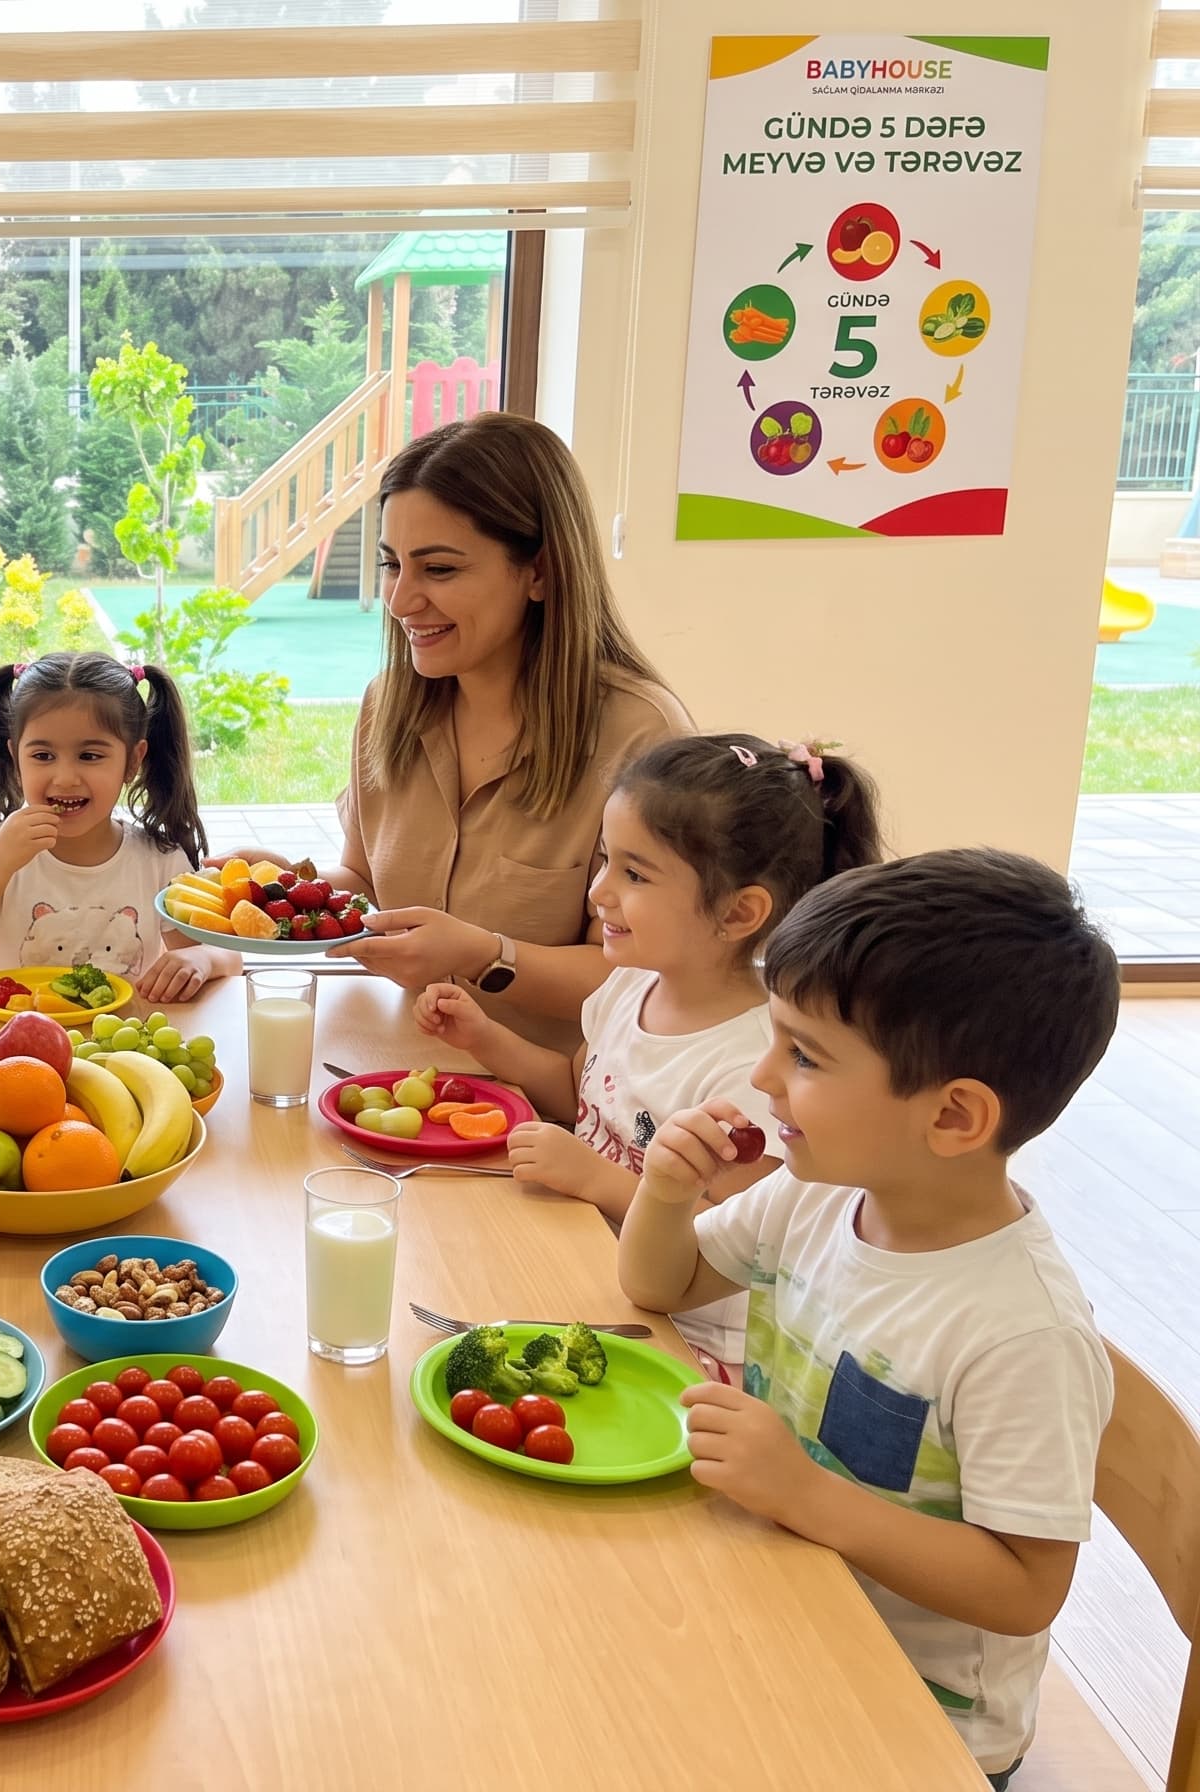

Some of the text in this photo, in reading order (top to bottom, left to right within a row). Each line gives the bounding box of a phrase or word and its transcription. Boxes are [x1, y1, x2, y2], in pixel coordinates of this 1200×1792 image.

[806, 59, 952, 80] BABYHOUSE
[763, 112, 986, 140] GÜNDƏ 5 DƏFƏ
[722, 150, 1023, 175] MEYVƏ VƏ TƏRƏVƏZ
[827, 292, 890, 308] GÜNDƏ
[828, 315, 878, 379] 5
[810, 385, 891, 399] TƏRƏVƏZ
